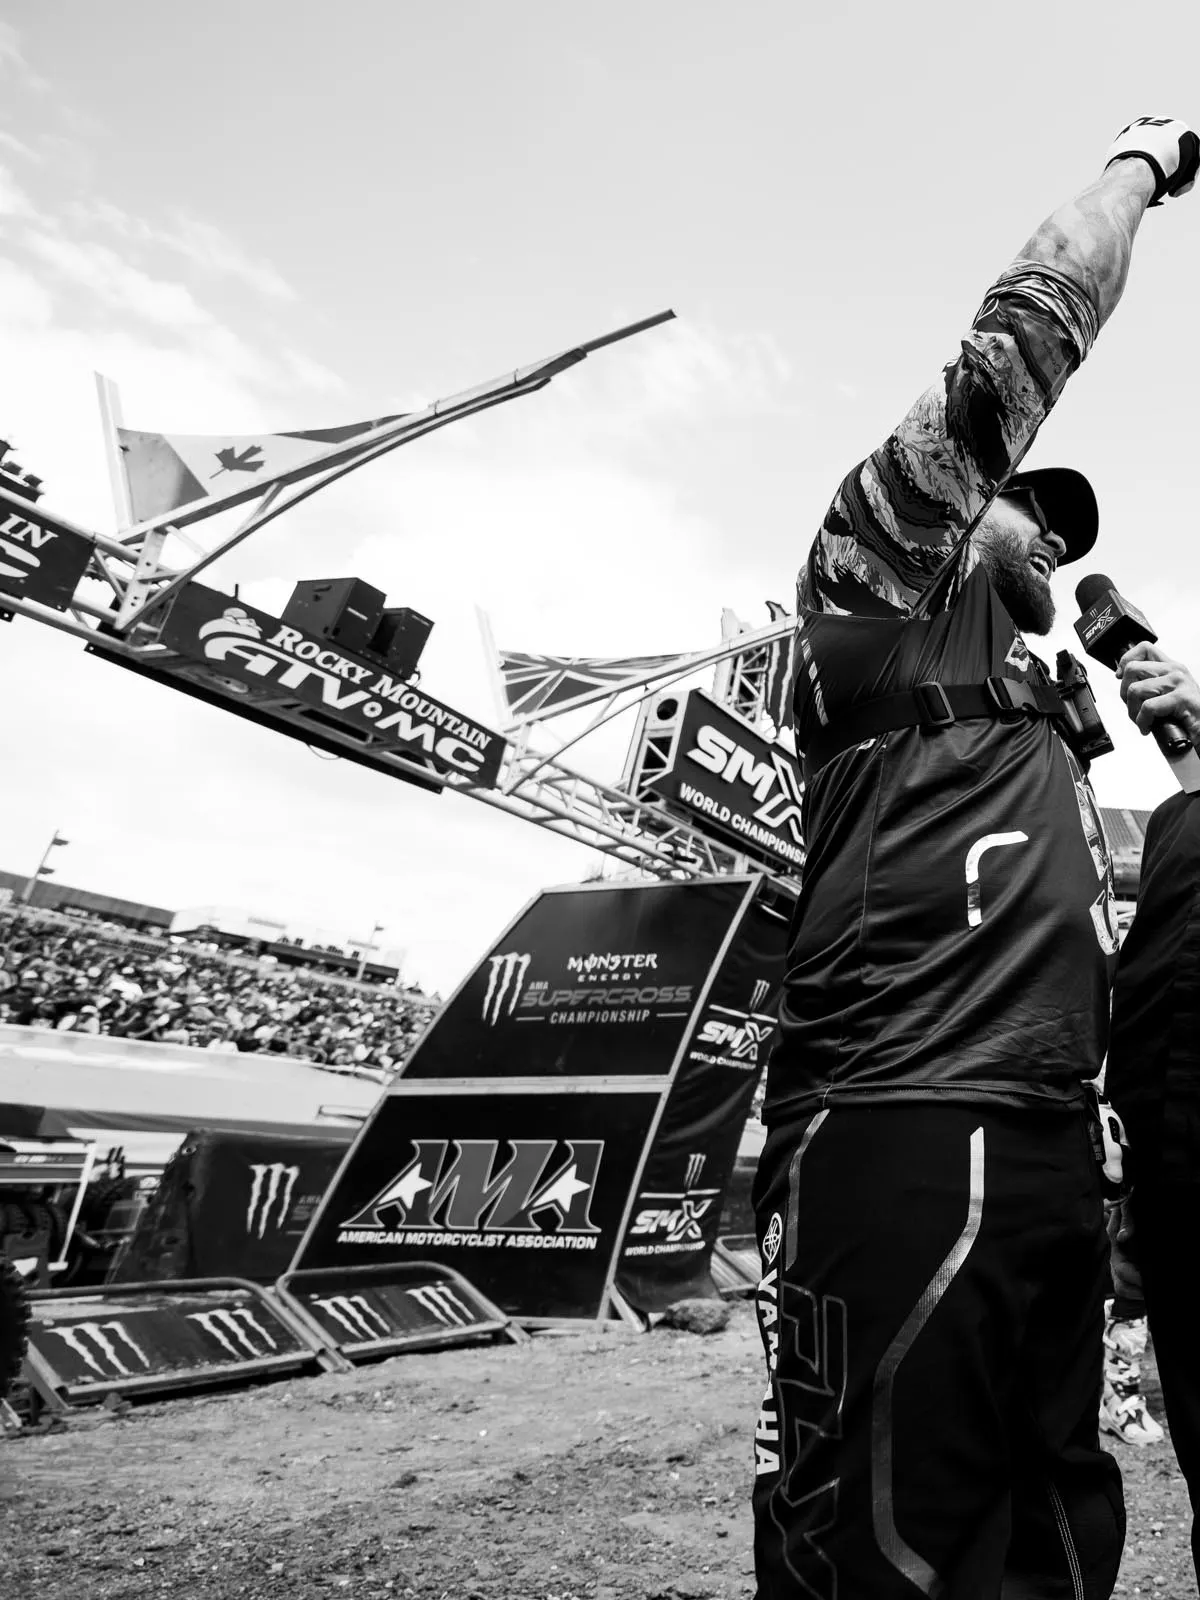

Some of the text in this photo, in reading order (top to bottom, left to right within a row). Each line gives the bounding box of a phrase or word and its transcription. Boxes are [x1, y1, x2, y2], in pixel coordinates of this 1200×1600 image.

[266, 625, 492, 750] ROCKY MOUNTAIN
[680, 783, 731, 822] WORLD
[520, 985, 694, 1007] SUPERCROSS
[529, 981, 549, 990] AMA
[577, 973, 642, 982] ENERGY
[550, 1009, 650, 1024] CHAMPIONSHIP
[697, 1020, 774, 1060] SMX
[339, 1139, 605, 1232] AMA
[630, 1199, 713, 1241] SMX
[337, 1231, 598, 1249] AMERICAN MOTORCYCLIST ASSOCIATION
[756, 1268, 781, 1475] YAMHA
